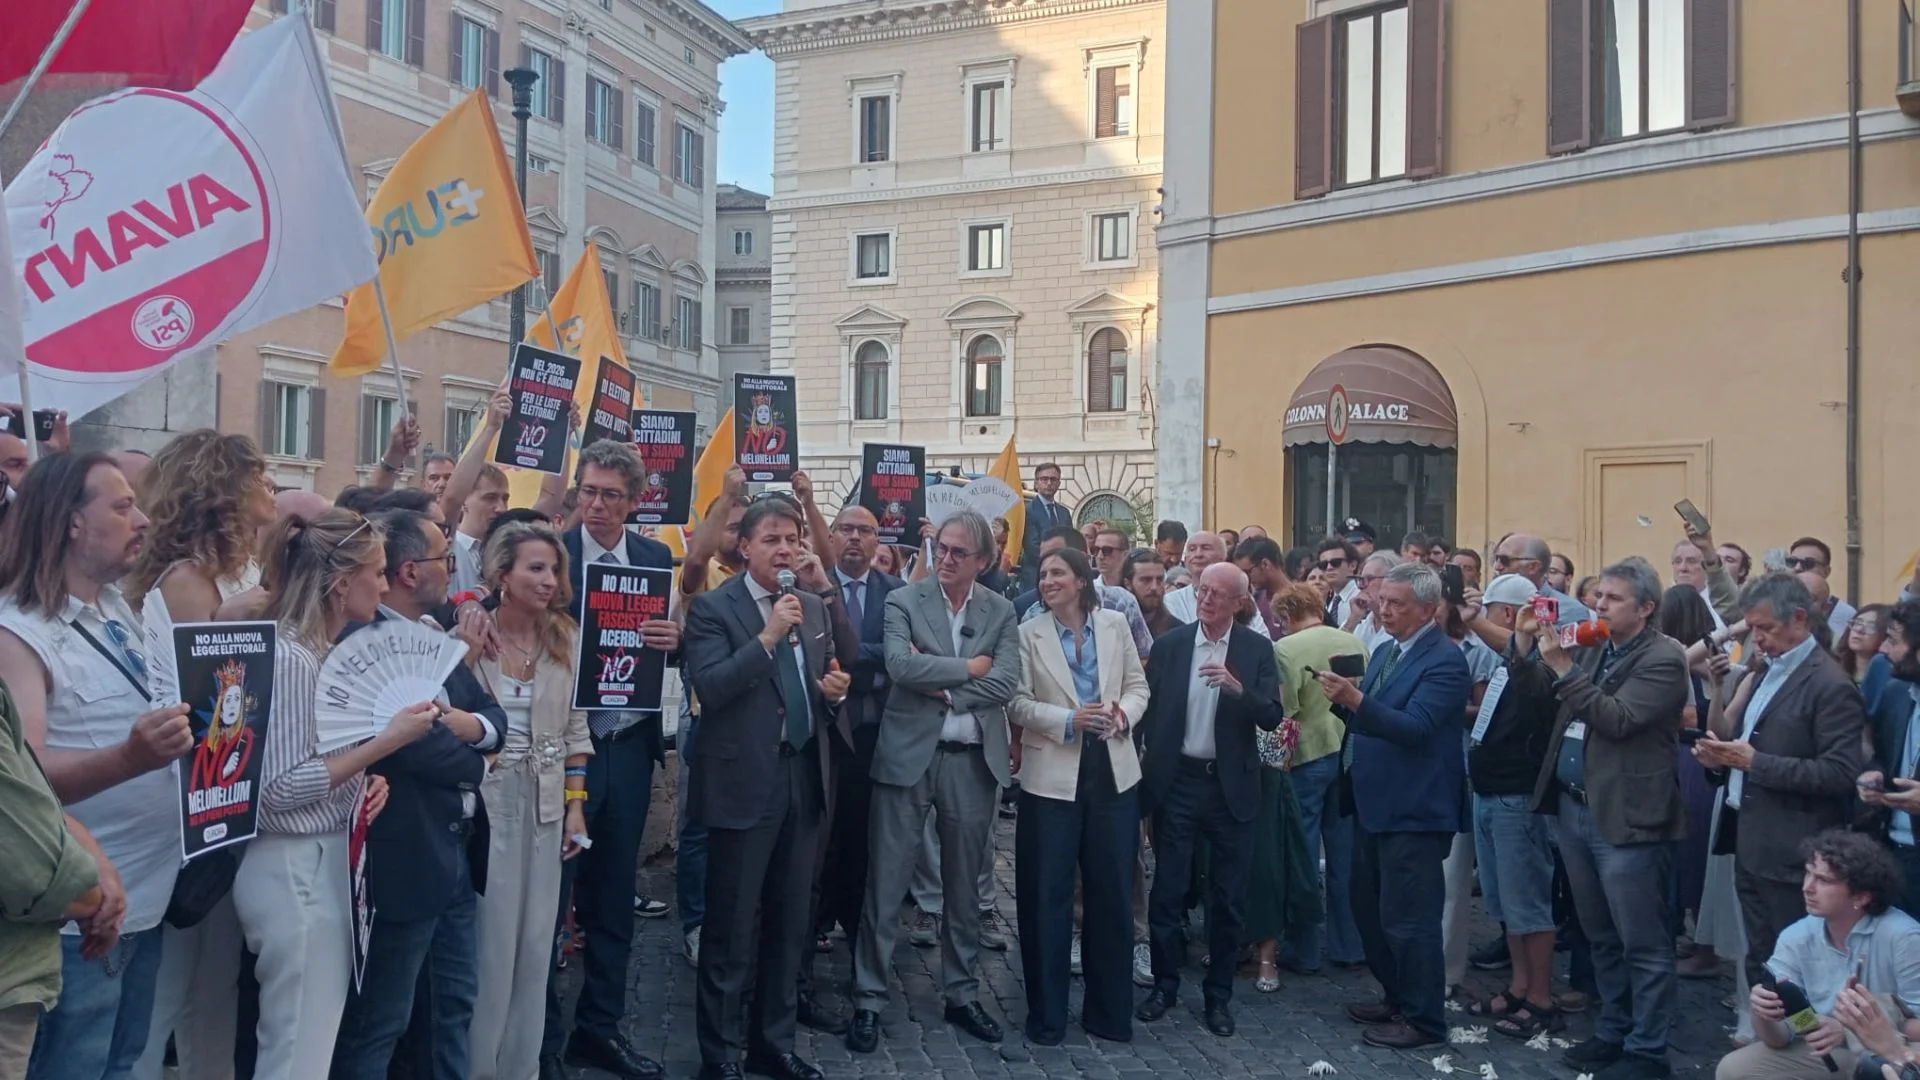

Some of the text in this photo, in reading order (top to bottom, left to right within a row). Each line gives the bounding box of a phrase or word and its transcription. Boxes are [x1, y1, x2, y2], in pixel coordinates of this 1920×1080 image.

[533, 358, 565, 376] NEL 2026
[520, 367, 536, 381] NON
[547, 375, 573, 390] ANCORA
[521, 391, 535, 404] PER
[535, 394, 544, 406] LE
[544, 396, 562, 411] LISTE
[601, 378, 609, 394] DI
[608, 382, 631, 405] ELETTORI
[520, 403, 557, 421] ELETTORALI
[594, 408, 614, 430] SENZA
[641, 415, 675, 429] SIAMO
[1286, 403, 1409, 424] COLONN ALACE
[519, 424, 546, 447] NO
[634, 429, 681, 444] CITTADINI
[742, 426, 787, 455] NO
[651, 444, 685, 458] SIAMO
[741, 453, 790, 464] MELONELLUM
[883, 449, 910, 462] SIAMO
[876, 461, 916, 475] CITTADINI
[871, 474, 920, 488] NON SIAMO
[602, 574, 649, 595] NO ALLA
[590, 591, 665, 613] NUOVA LEGGE
[195, 632, 263, 645] NO ALLA NUOVA
[191, 643, 267, 656] LEGGE ELETTORALE
[326, 635, 441, 710] NO MELONELLUM
[601, 655, 635, 682] NO
[190, 726, 255, 793] NO
[188, 780, 252, 815] MELONELLUM
